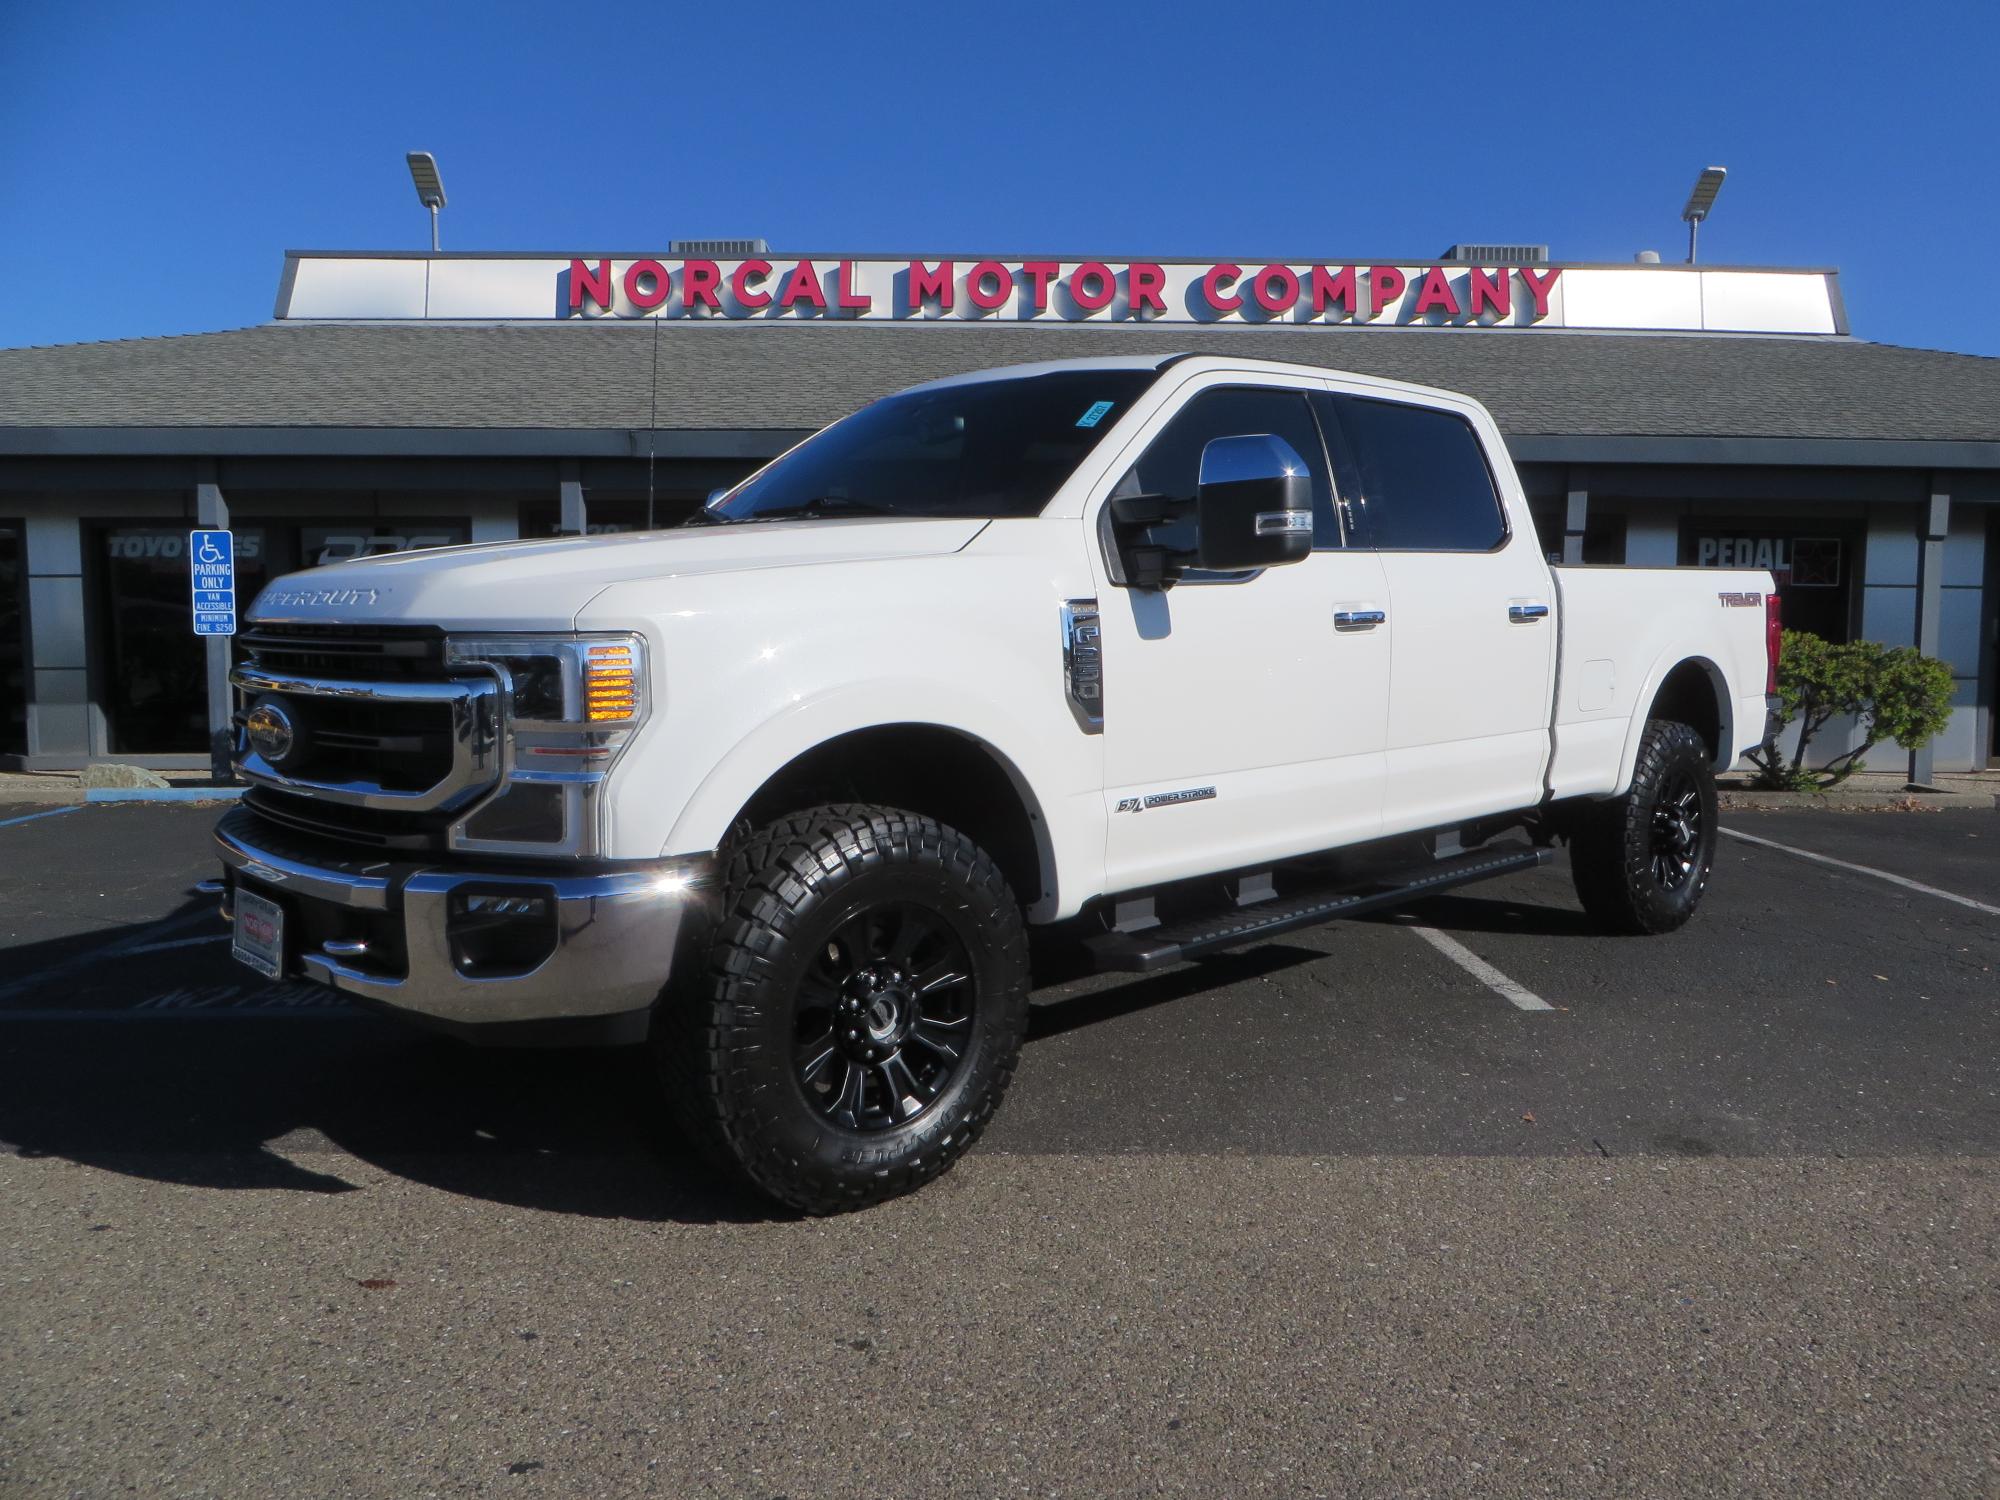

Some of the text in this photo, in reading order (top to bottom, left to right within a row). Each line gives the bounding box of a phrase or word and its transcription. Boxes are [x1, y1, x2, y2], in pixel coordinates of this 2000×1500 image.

[569, 259, 1563, 316] NORCAL MOTOR COMPANY
[108, 536, 183, 557] TOYO
[1698, 537, 1791, 570] PEDAL
[194, 563, 231, 576] PARKING
[201, 576, 225, 589] ONLY
[207, 592, 220, 601] VAN
[1718, 592, 1762, 608] TREMOR
[196, 602, 232, 611] ACCESSIBLE
[200, 614, 229, 622] MINIMUM
[196, 623, 233, 632] FINE $250
[1148, 792, 1180, 805] POWER
[1181, 787, 1215, 799] STROKE
